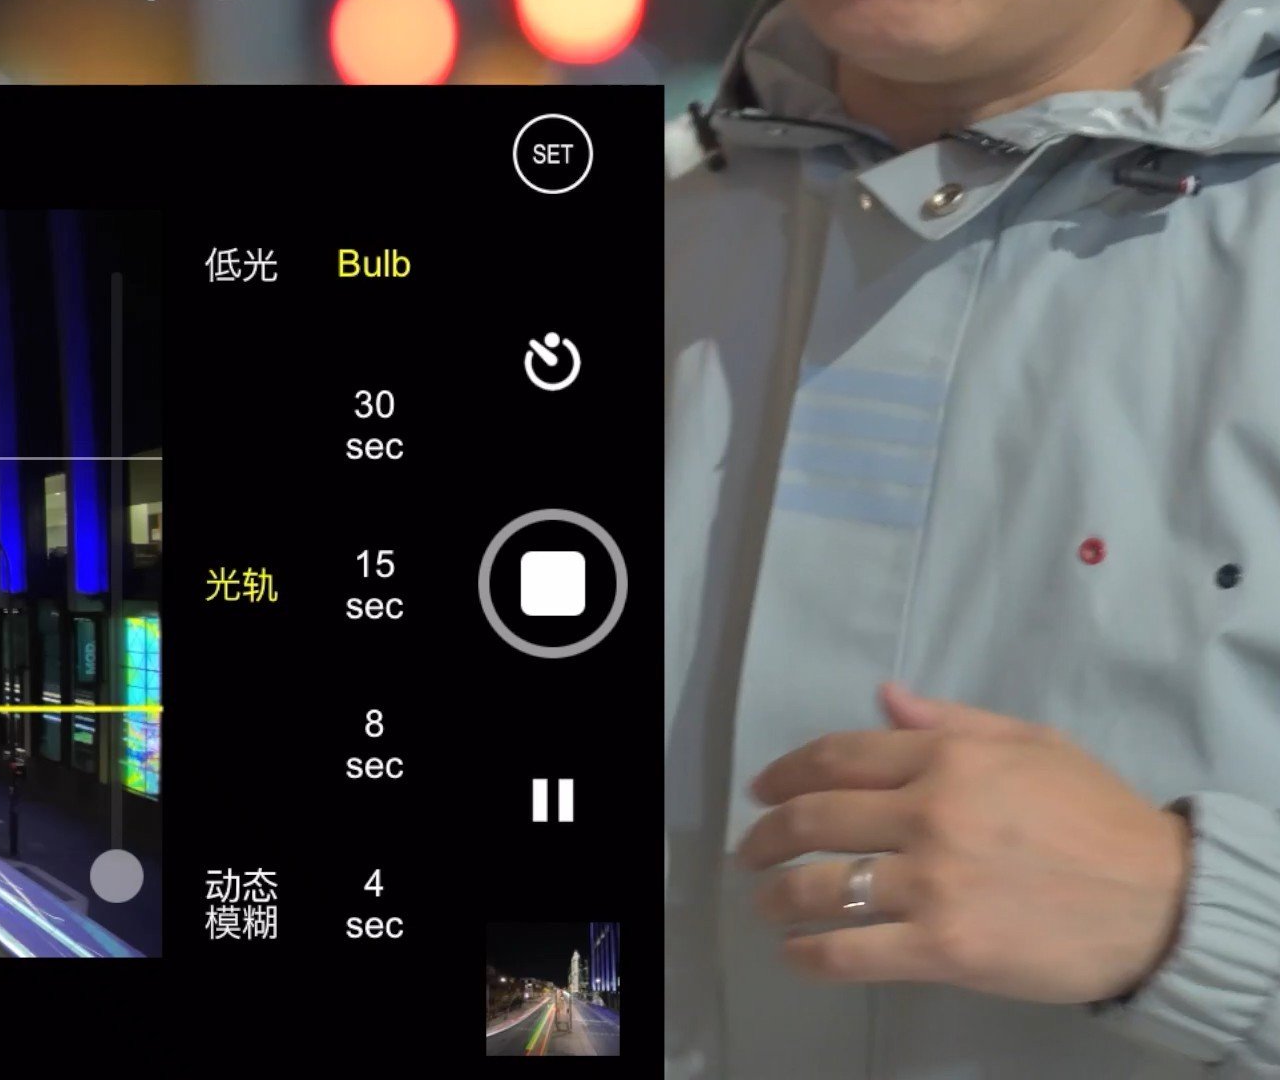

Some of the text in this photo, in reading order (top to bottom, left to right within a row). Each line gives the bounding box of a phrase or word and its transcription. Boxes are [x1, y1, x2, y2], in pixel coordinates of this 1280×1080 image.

[532, 143, 574, 165] SET
[204, 247, 278, 283] 低光
[337, 248, 412, 279] Bulb
[354, 389, 395, 419] 30
[345, 437, 404, 460] sec
[356, 549, 395, 578] 15
[205, 566, 279, 603] 光轨
[345, 597, 404, 620] sec
[364, 708, 384, 738] 8
[345, 756, 404, 779] sec
[205, 867, 278, 903] 动态
[363, 868, 384, 898] 4
[205, 904, 278, 940] 模糊
[345, 916, 404, 939] sec
